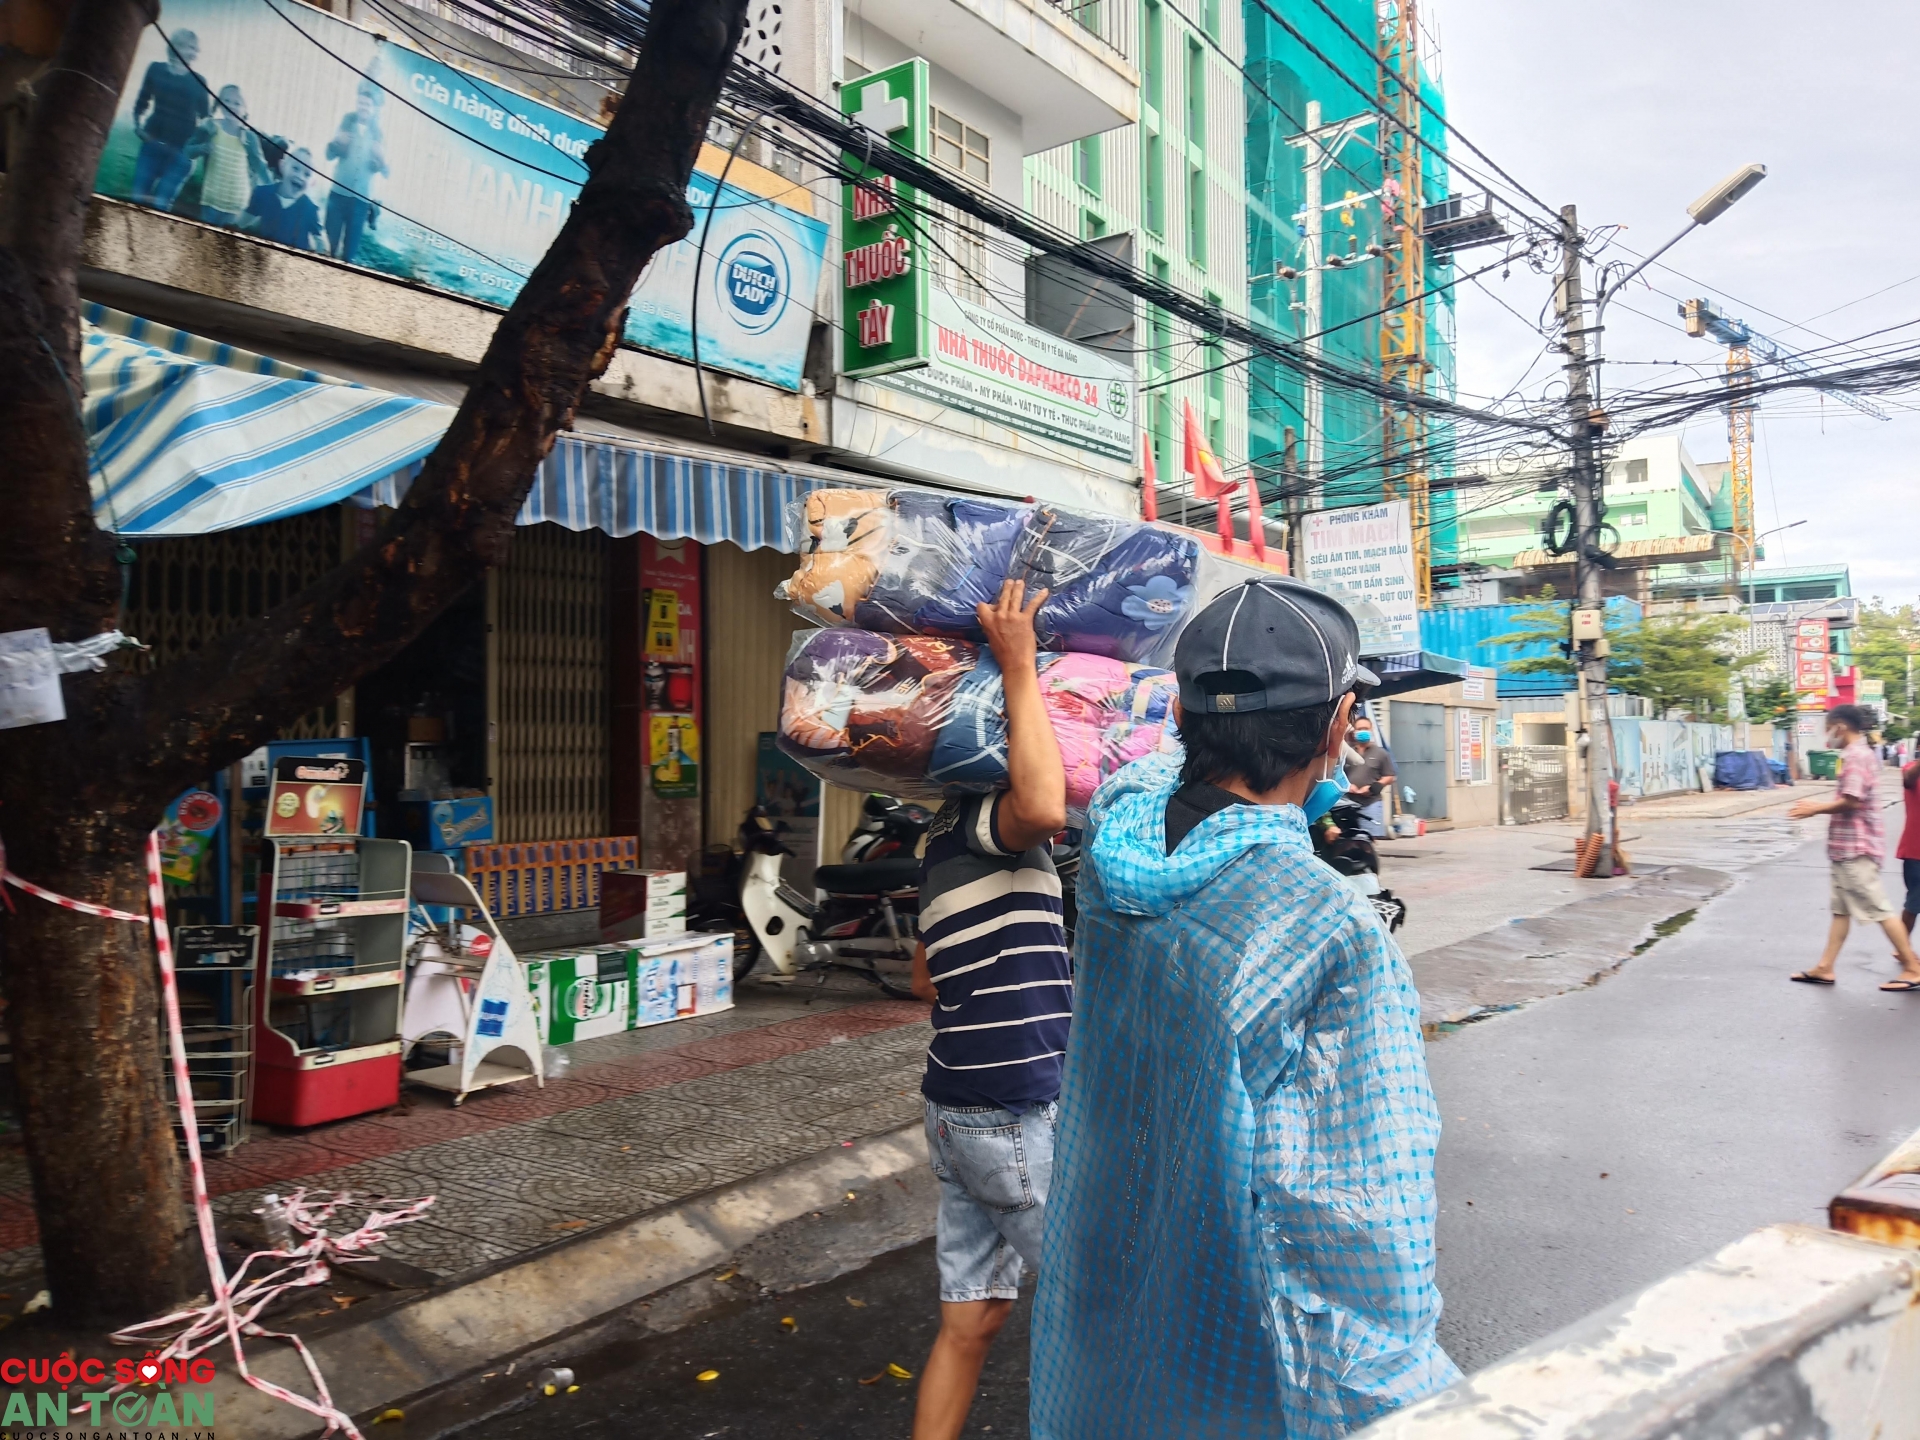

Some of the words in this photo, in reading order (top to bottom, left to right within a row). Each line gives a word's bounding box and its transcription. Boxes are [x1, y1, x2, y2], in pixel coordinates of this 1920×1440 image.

[453, 89, 505, 131] hàng
[844, 224, 911, 289] THUỐC
[731, 263, 776, 291] DUTCH
[733, 281, 772, 305] LADY
[857, 298, 895, 347] TÂY
[979, 316, 987, 326] TY
[938, 325, 969, 362] NHÀ
[971, 338, 1015, 379] THUỐC
[1084, 381, 1099, 408] 34
[1329, 510, 1360, 526] PHÒNG
[1361, 507, 1389, 521] KHÁM
[1311, 528, 1344, 550] TIM
[1330, 550, 1343, 563] ÂM
[1347, 581, 1363, 590] TIM
[1384, 575, 1405, 586] SINH
